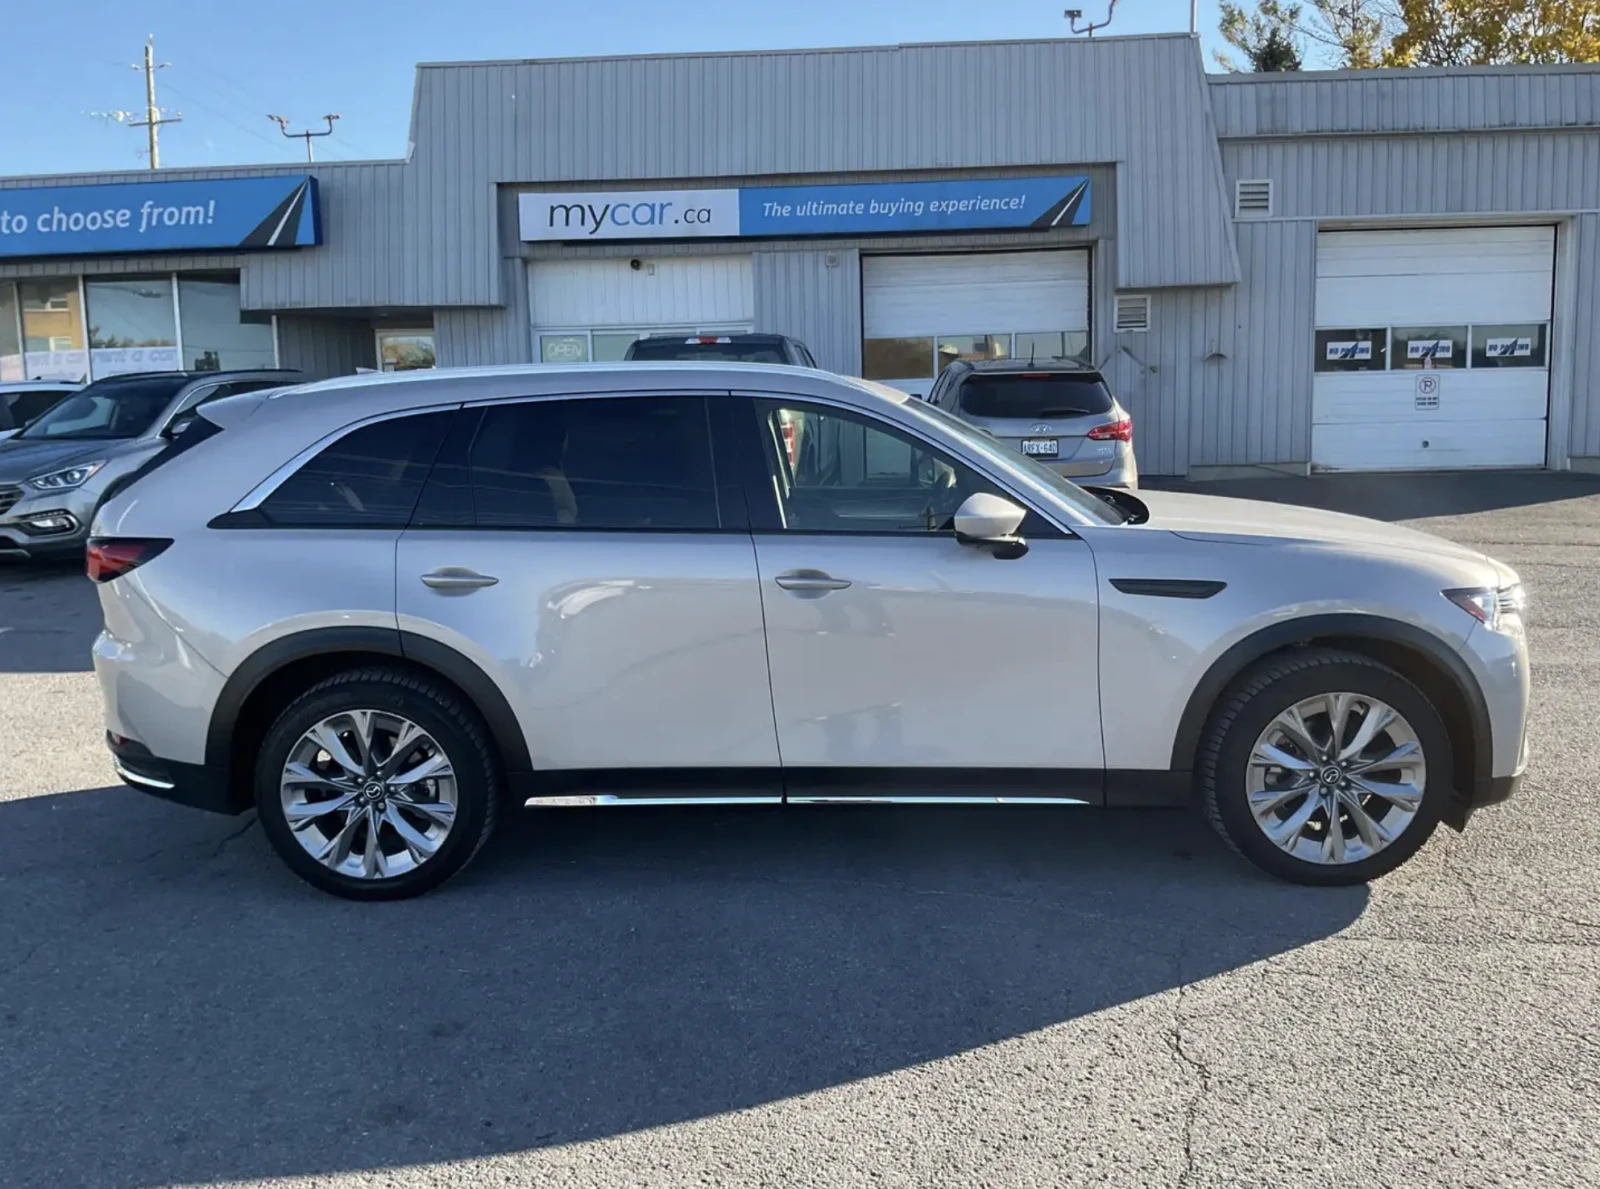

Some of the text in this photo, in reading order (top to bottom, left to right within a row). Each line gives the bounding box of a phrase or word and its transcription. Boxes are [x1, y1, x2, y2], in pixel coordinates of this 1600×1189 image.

[763, 194, 1026, 217] The ultimate buying experience!
[0, 200, 216, 235] to choose from!
[549, 202, 711, 235] mycar.ca
[547, 342, 582, 357] OPEN
[1340, 346, 1370, 354] PAING
[1421, 345, 1451, 353] PAING
[1500, 343, 1529, 351] PAING
